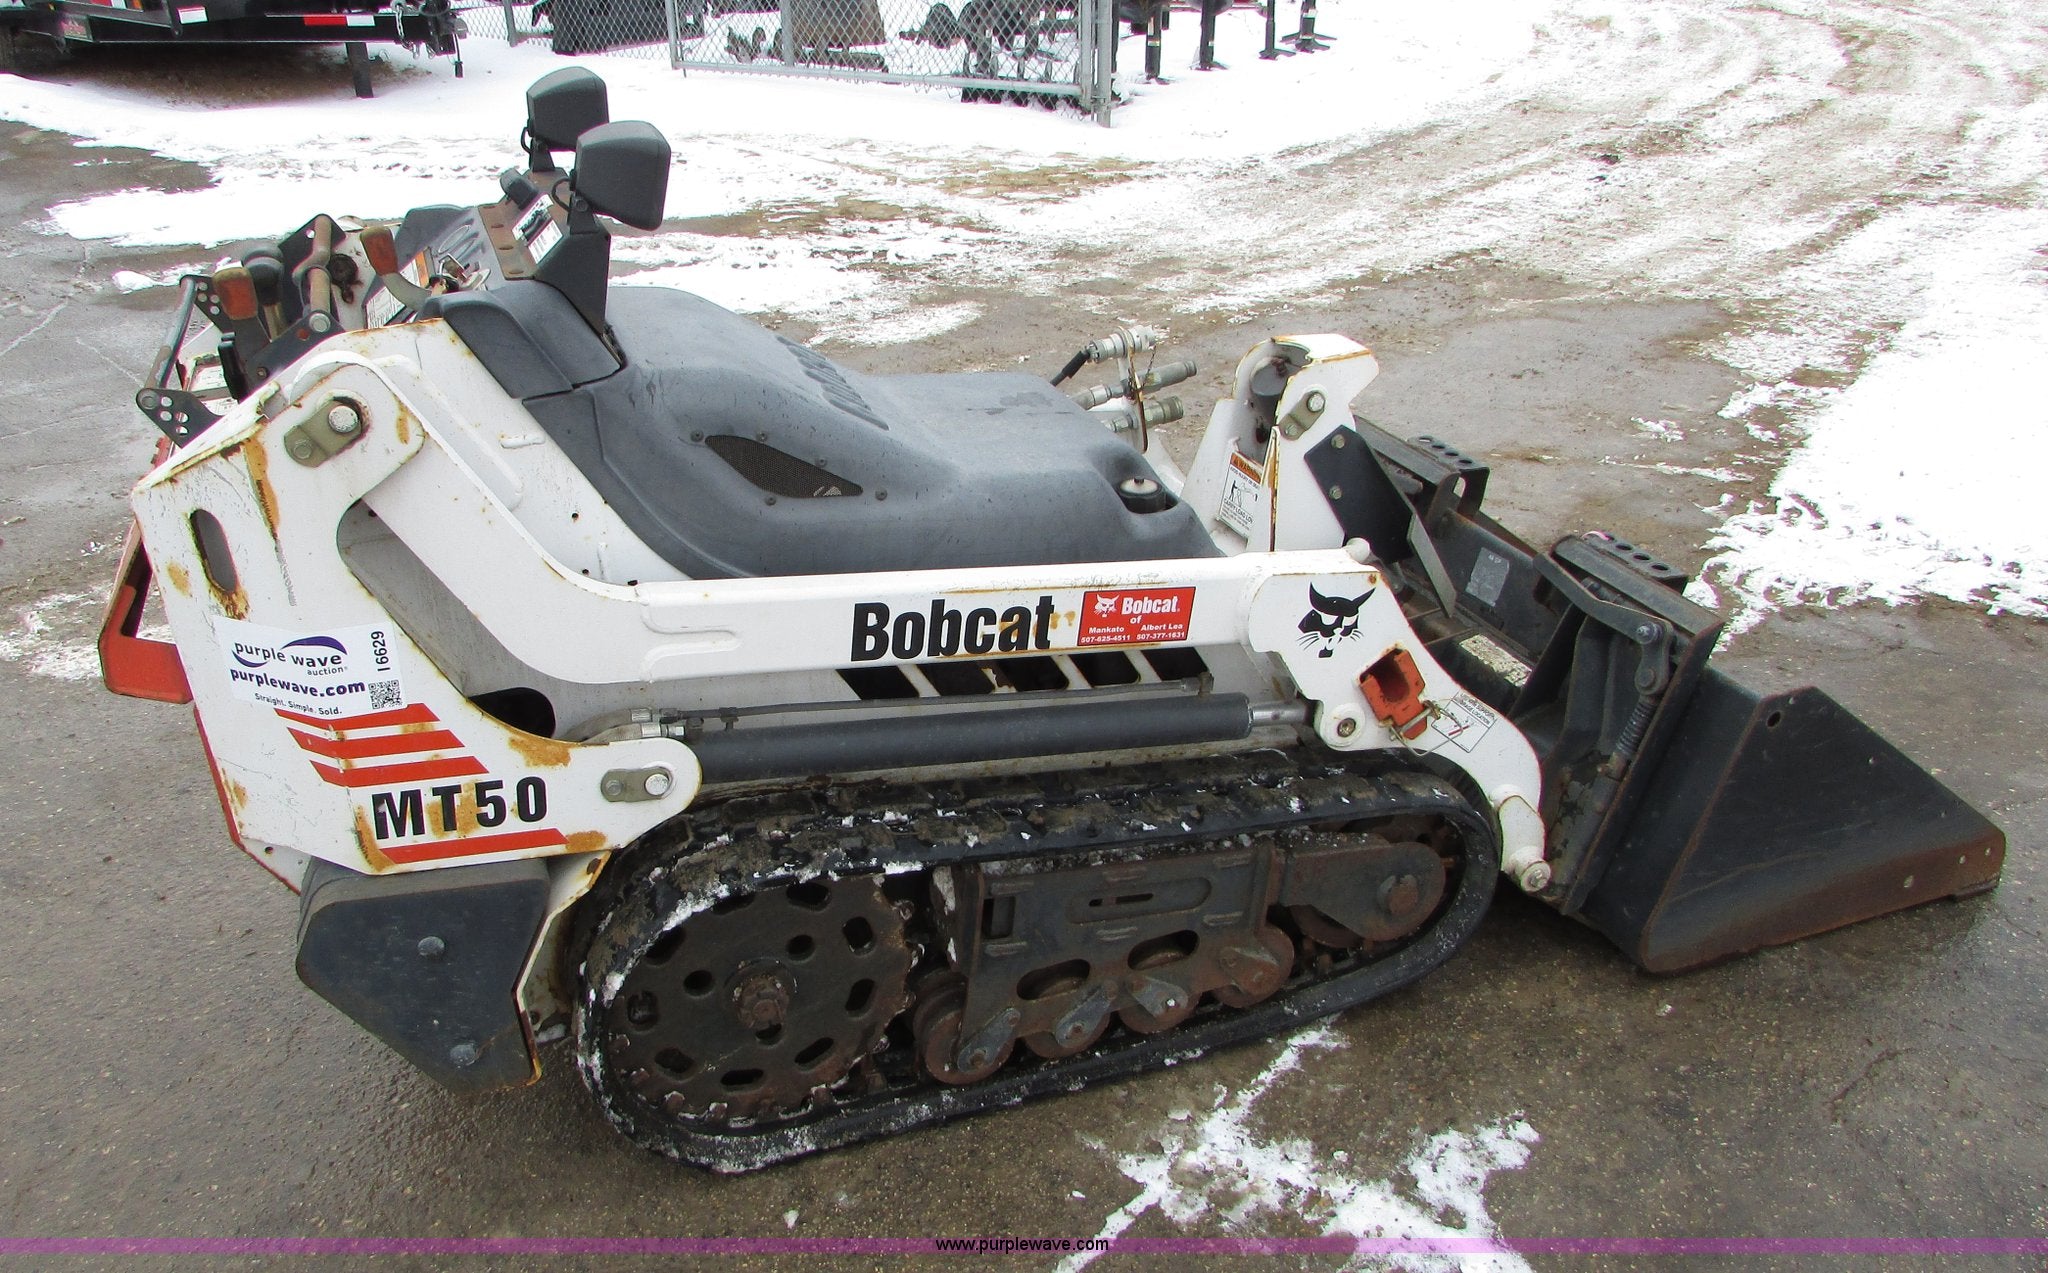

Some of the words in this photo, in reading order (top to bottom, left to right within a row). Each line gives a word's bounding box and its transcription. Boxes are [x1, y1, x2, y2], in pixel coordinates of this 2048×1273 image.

[1121, 596, 1179, 615] Bobcat
[851, 595, 1055, 662] Bobcat
[1088, 626, 1125, 634] Mankato
[1130, 615, 1142, 624] of
[1141, 623, 1166, 632] Albert
[234, 642, 287, 662] purple
[291, 654, 342, 668] wave
[371, 631, 391, 672] 16629
[230, 668, 366, 697] purplewave.com
[255, 693, 286, 706] Straight.
[288, 701, 317, 713] Simple.
[318, 707, 342, 716] Sold.
[372, 776, 547, 840] MT50
